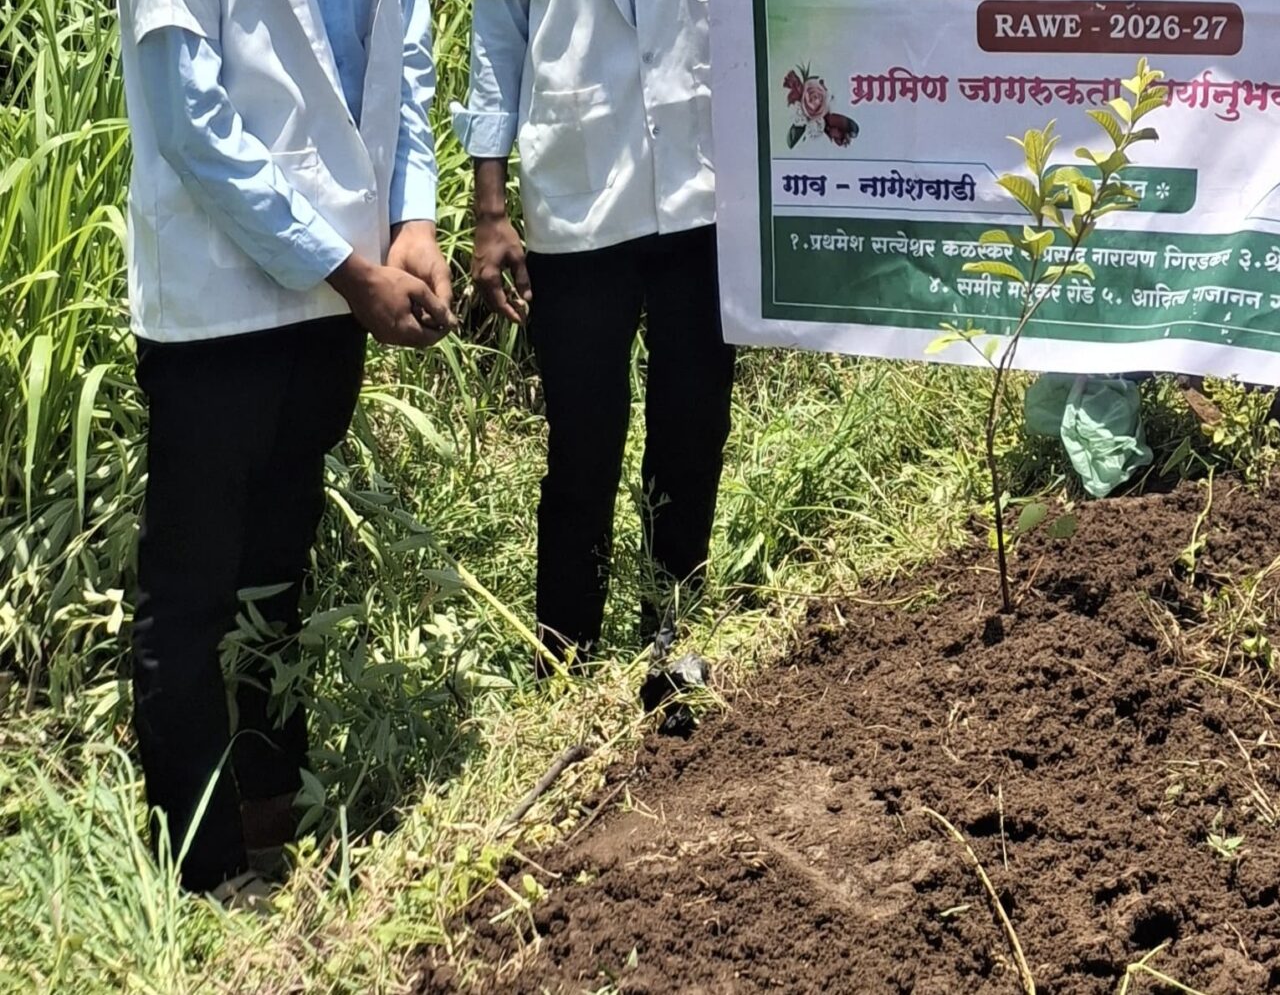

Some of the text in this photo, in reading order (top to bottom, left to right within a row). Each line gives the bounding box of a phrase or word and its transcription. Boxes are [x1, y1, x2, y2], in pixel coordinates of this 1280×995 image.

[994, 14, 1082, 39] RAWE
[1109, 14, 1229, 40] 2026-27
[850, 66, 948, 105] ग्रामिण
[783, 173, 826, 197] गाव
[859, 170, 976, 202] नागेशवाडी
[1092, 247, 1156, 268] नारायण
[957, 272, 1003, 299] समीर
